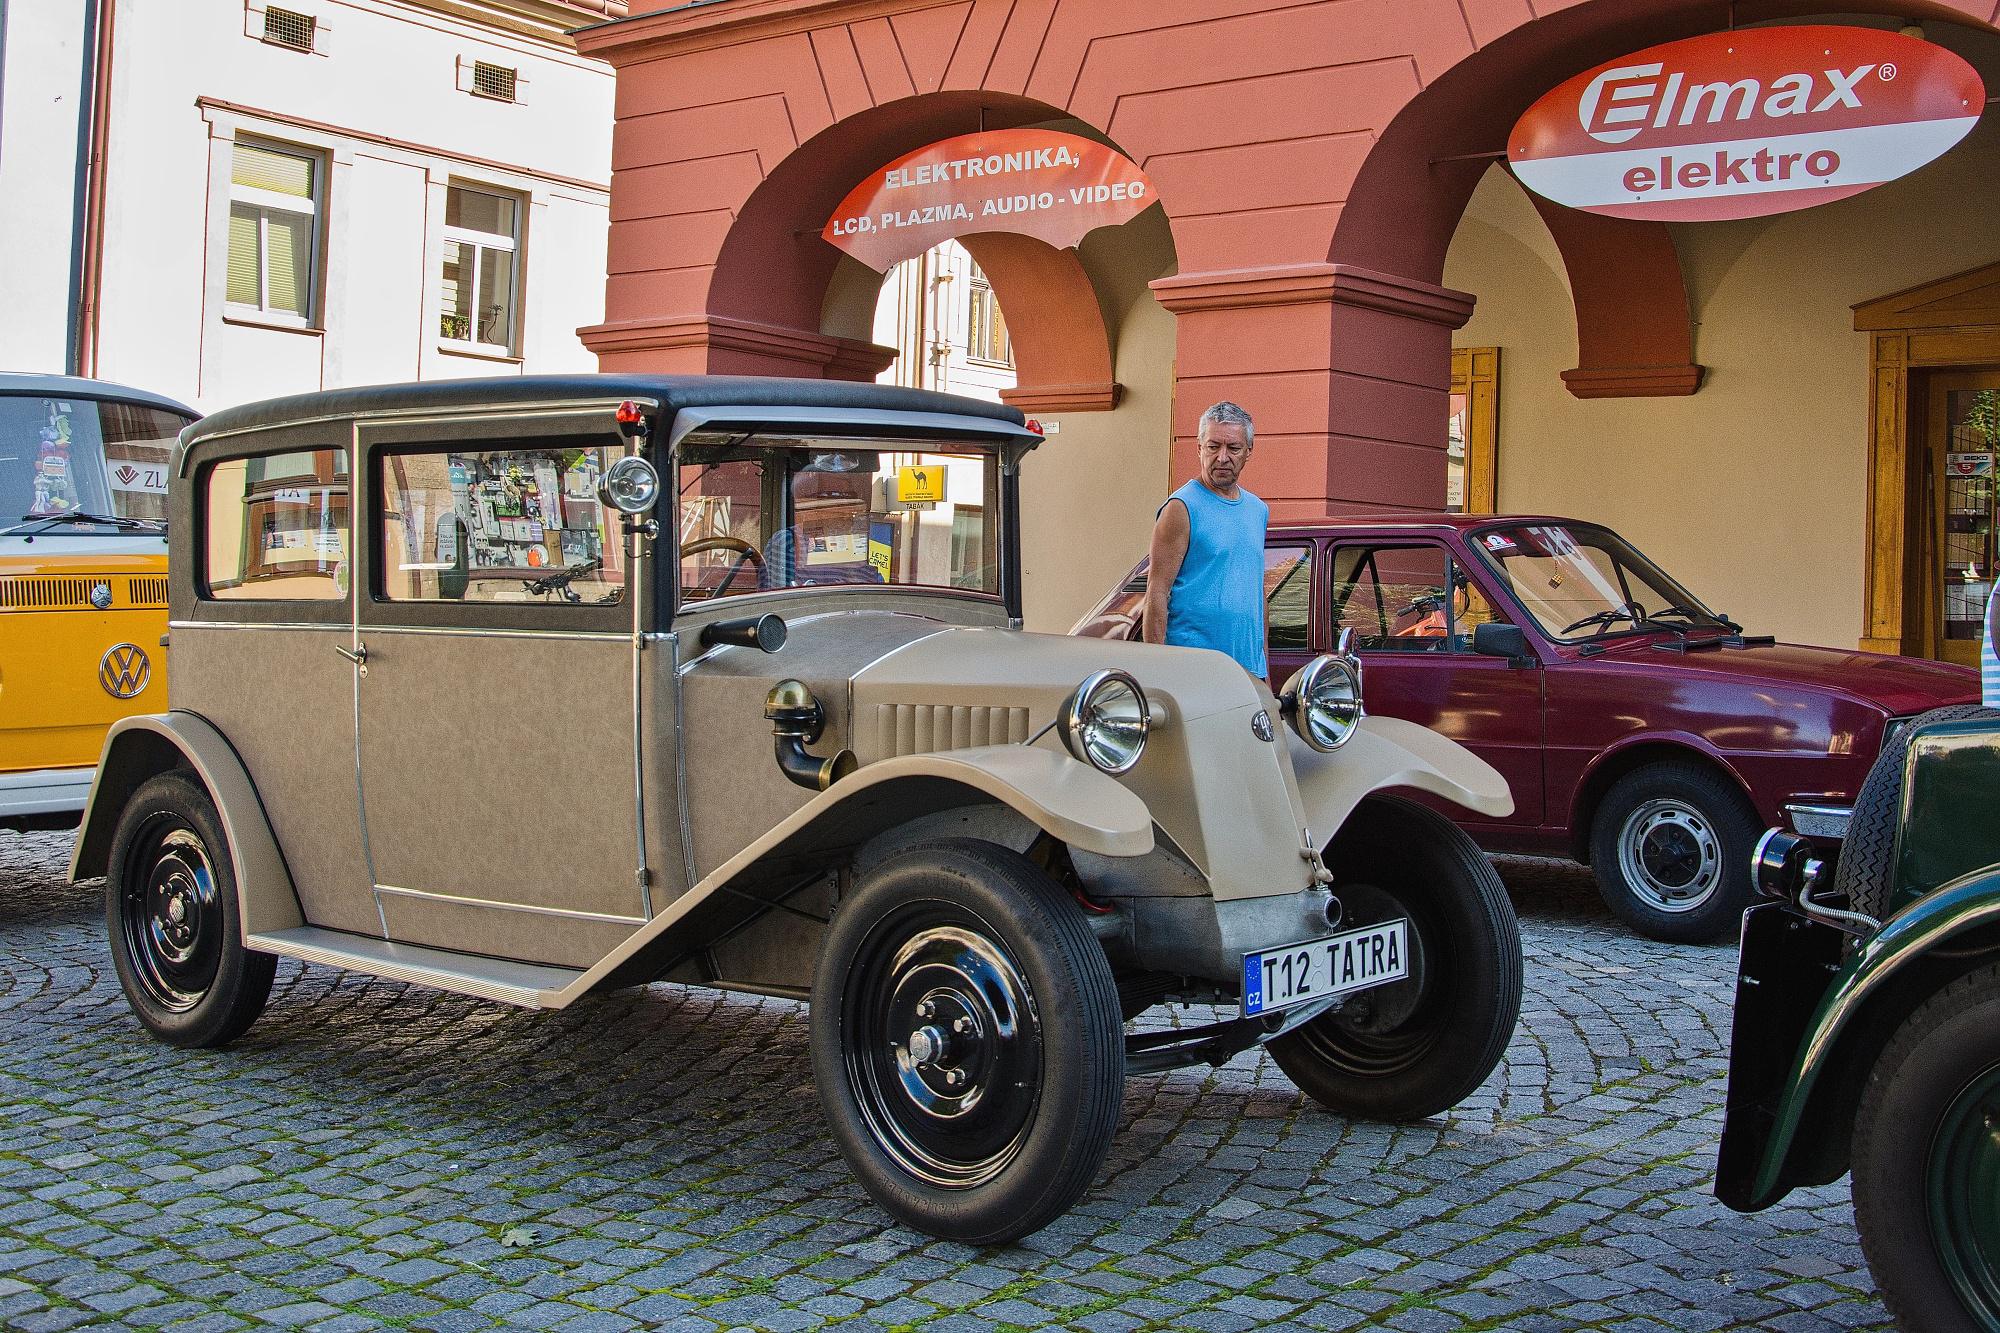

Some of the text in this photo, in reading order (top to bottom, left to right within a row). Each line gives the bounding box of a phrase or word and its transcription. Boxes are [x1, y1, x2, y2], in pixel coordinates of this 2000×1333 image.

[885, 146, 1080, 189] ELEKTRONIKA,
[1622, 147, 1841, 192] elektro
[833, 216, 877, 236] LCD,
[881, 203, 974, 229] PLAZMA,
[981, 192, 1054, 216] AUDIO
[1069, 181, 1146, 205] VIDEO
[1263, 930, 1400, 1002] T12 TATRA
[1247, 991, 1261, 1007] CZ
